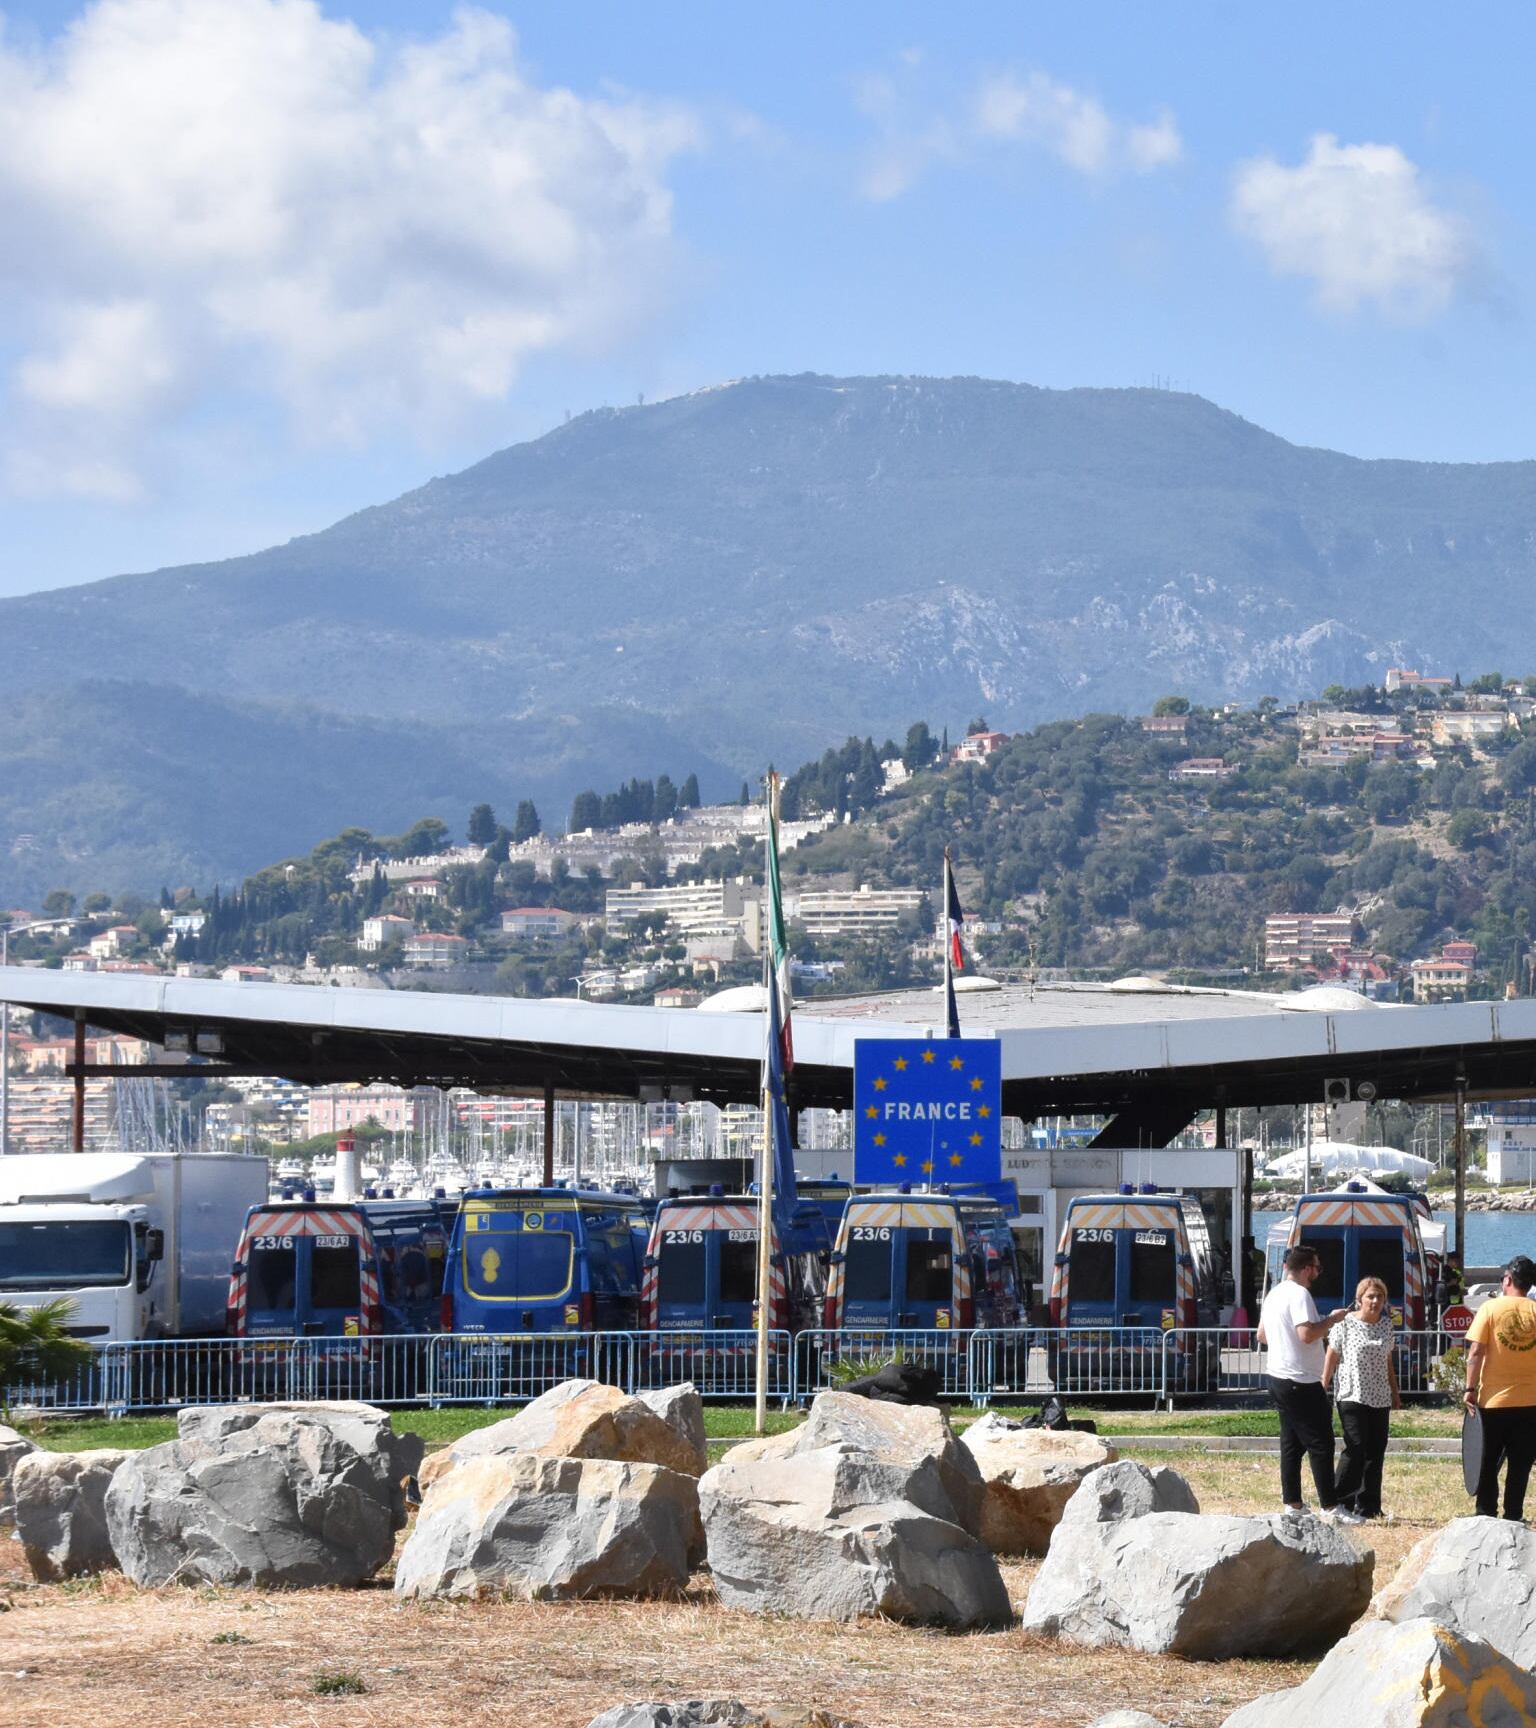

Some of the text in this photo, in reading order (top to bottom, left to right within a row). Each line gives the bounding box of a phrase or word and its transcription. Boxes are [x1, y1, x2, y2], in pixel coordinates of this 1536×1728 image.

[884, 1102, 971, 1120] FRANCE
[665, 1230, 703, 1244] 23/6
[853, 1227, 890, 1241] 23/6
[1077, 1229, 1114, 1242] 23/6
[254, 1236, 293, 1249] 23/6
[1445, 1316, 1473, 1328] STOP
